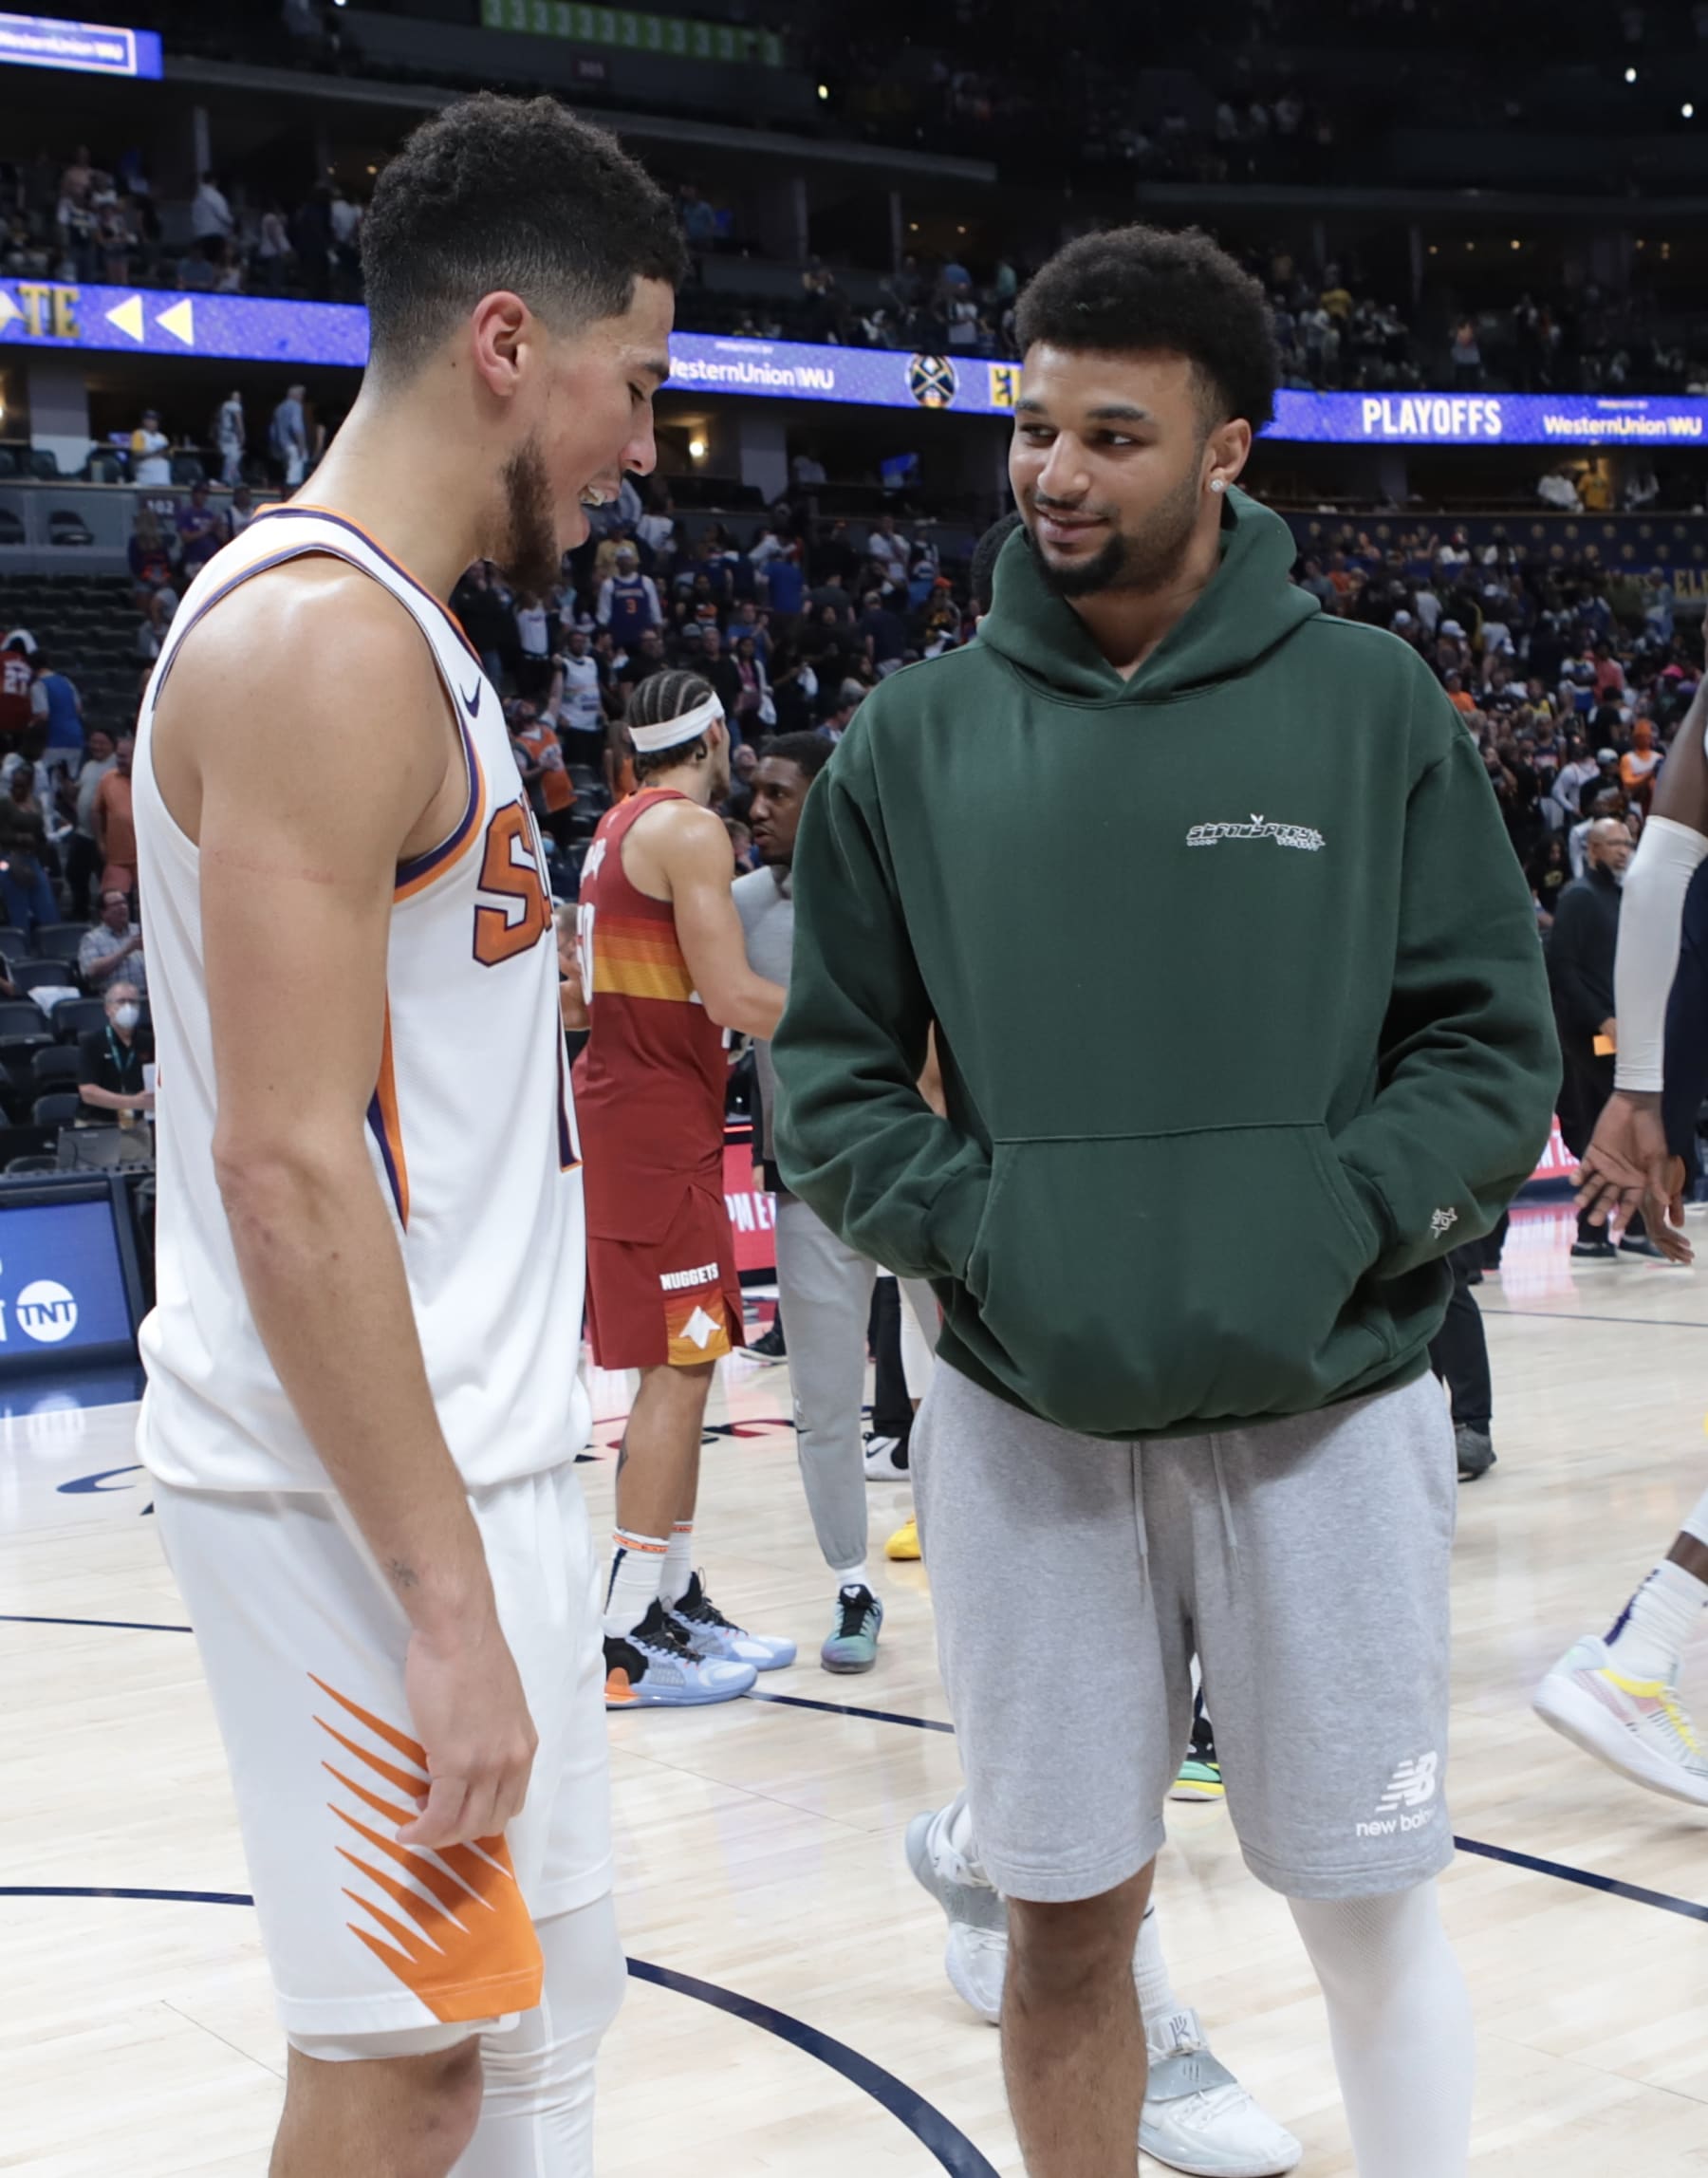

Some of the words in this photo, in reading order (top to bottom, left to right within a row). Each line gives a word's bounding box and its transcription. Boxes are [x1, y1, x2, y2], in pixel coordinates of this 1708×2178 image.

[1362, 398, 1502, 436] PLAYOFFS
[1543, 415, 1667, 436] WesternUnion
[473, 790, 554, 968] S
[659, 1262, 719, 1291] NUGGETS
[17, 1300, 75, 1326] TNT
[1355, 1819, 1397, 1837] new
